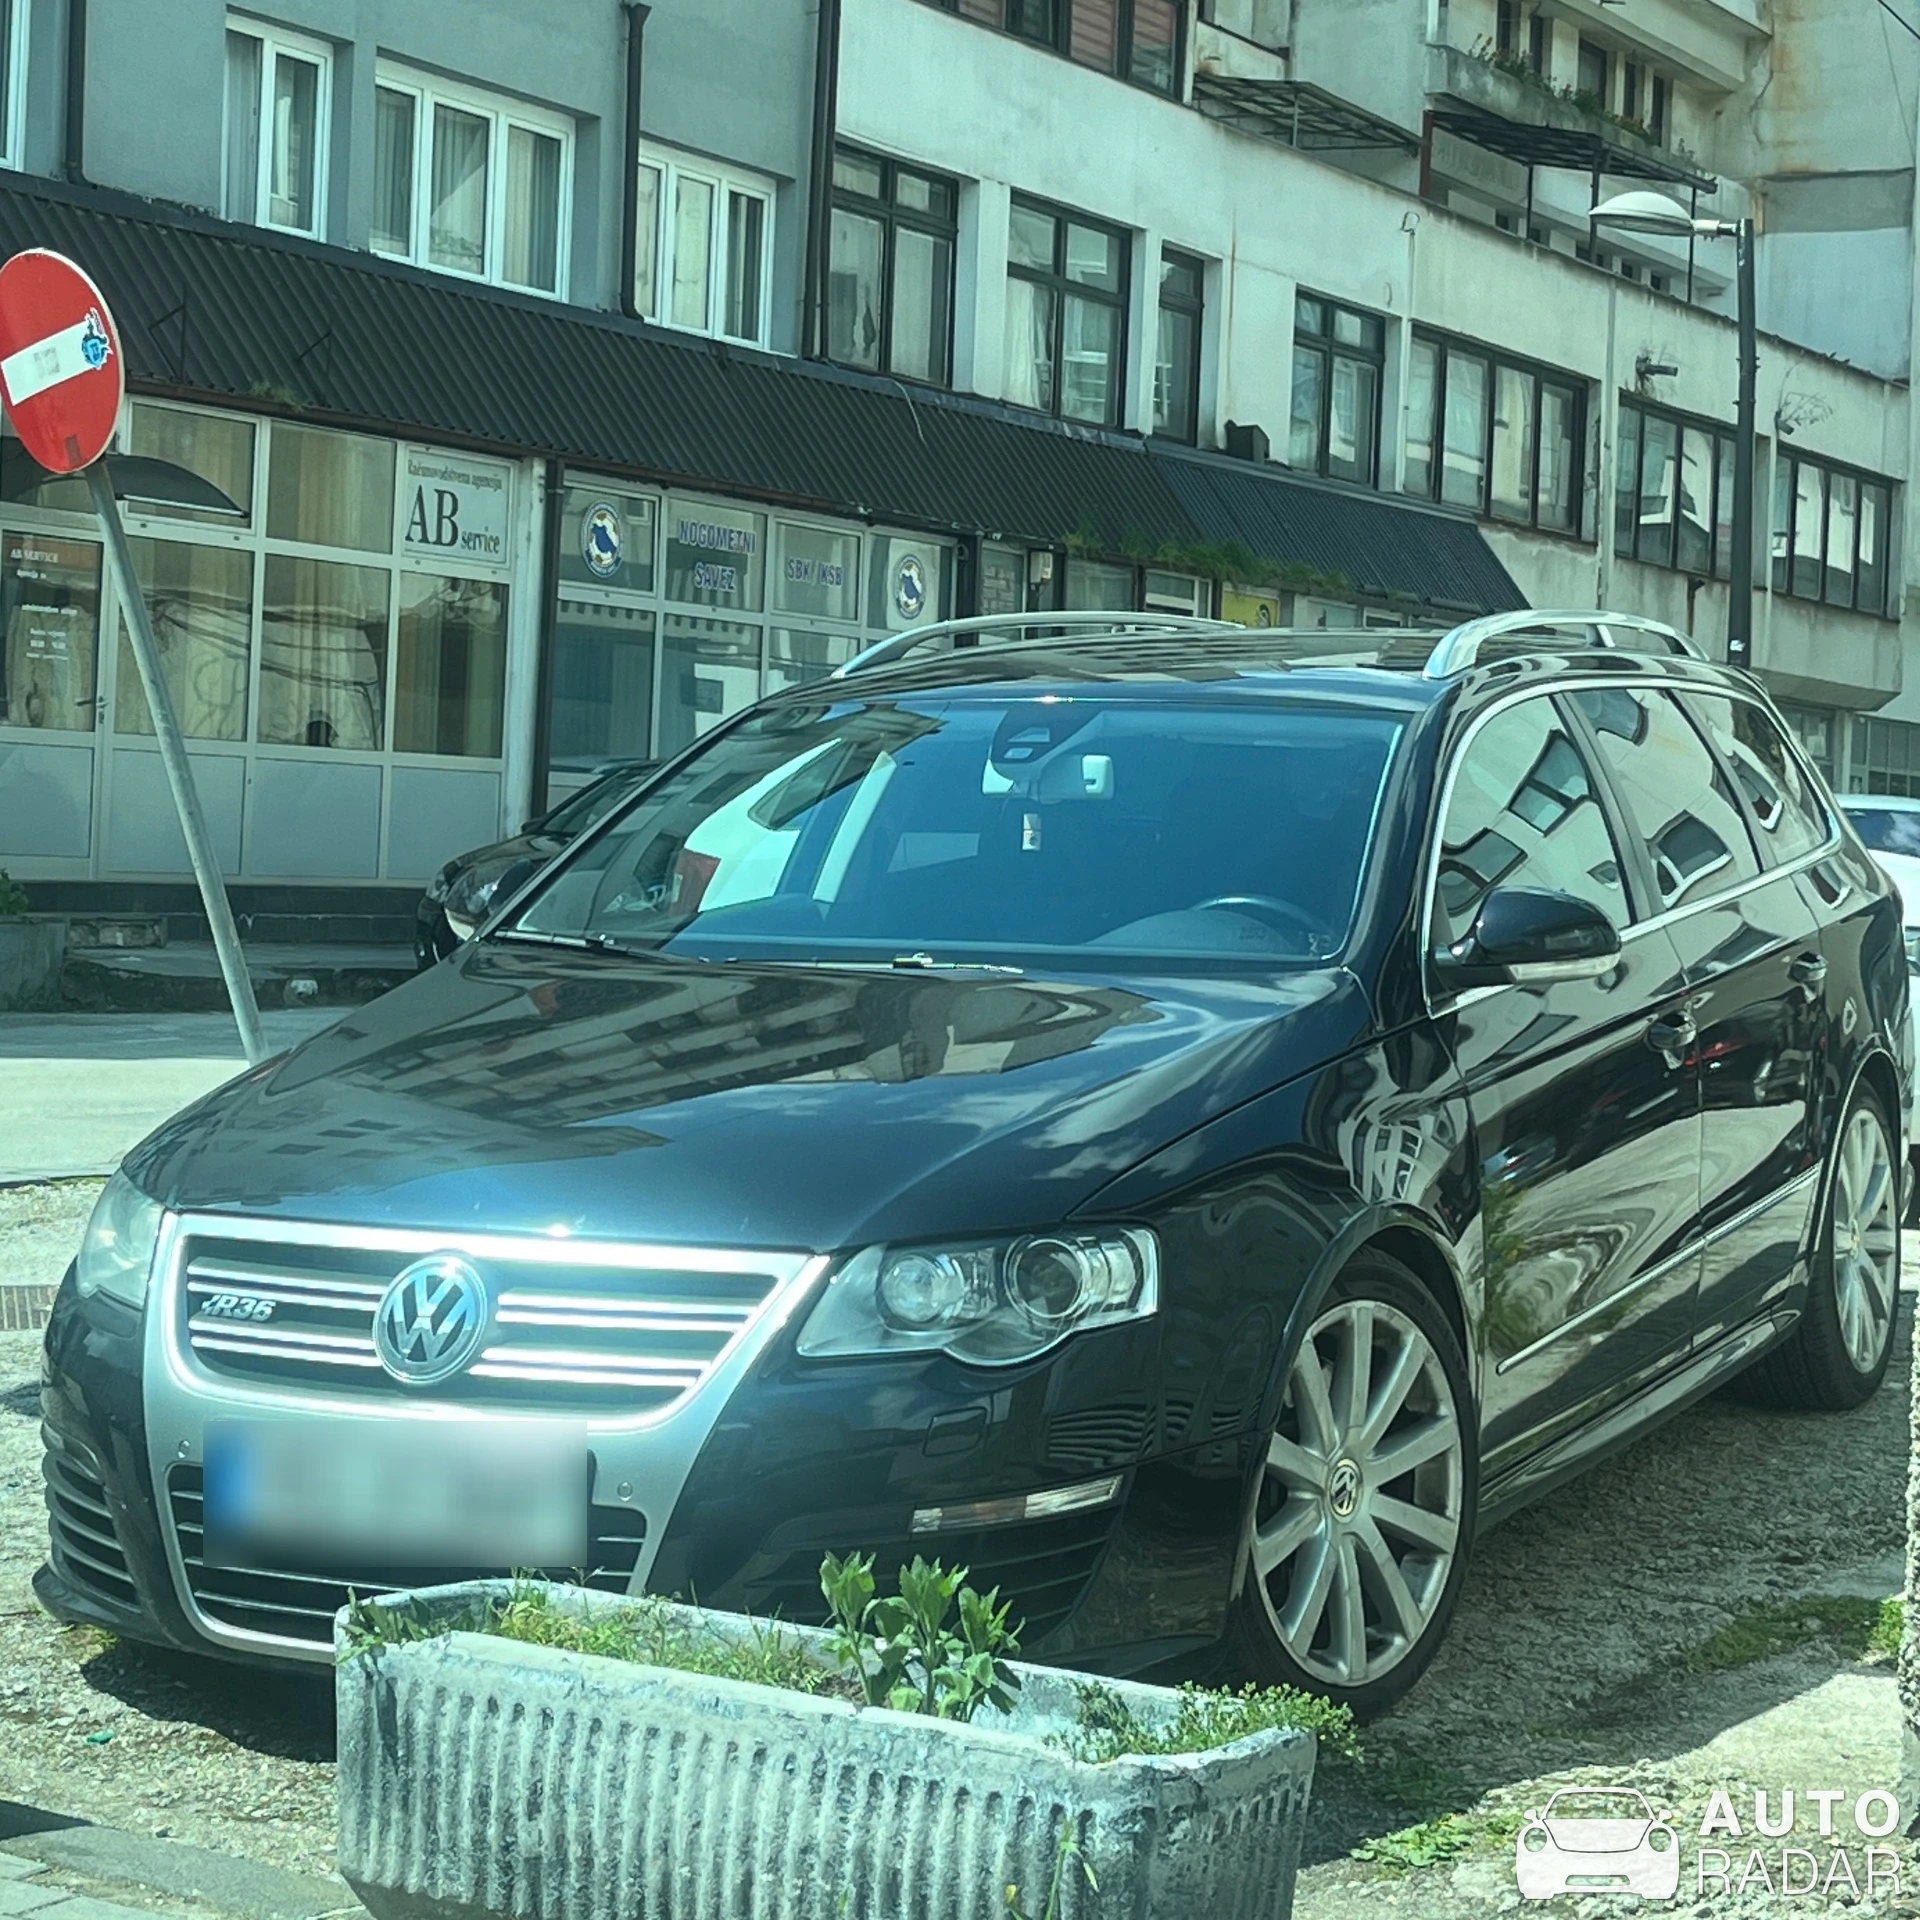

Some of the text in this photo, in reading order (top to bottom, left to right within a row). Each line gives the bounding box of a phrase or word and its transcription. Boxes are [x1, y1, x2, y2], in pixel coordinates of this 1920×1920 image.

[405, 484, 500, 554] AB service
[679, 519, 757, 556] NOGOMETNI
[694, 561, 736, 593] SAVEZ
[787, 556, 811, 583] SBK
[819, 561, 844, 588] KSB
